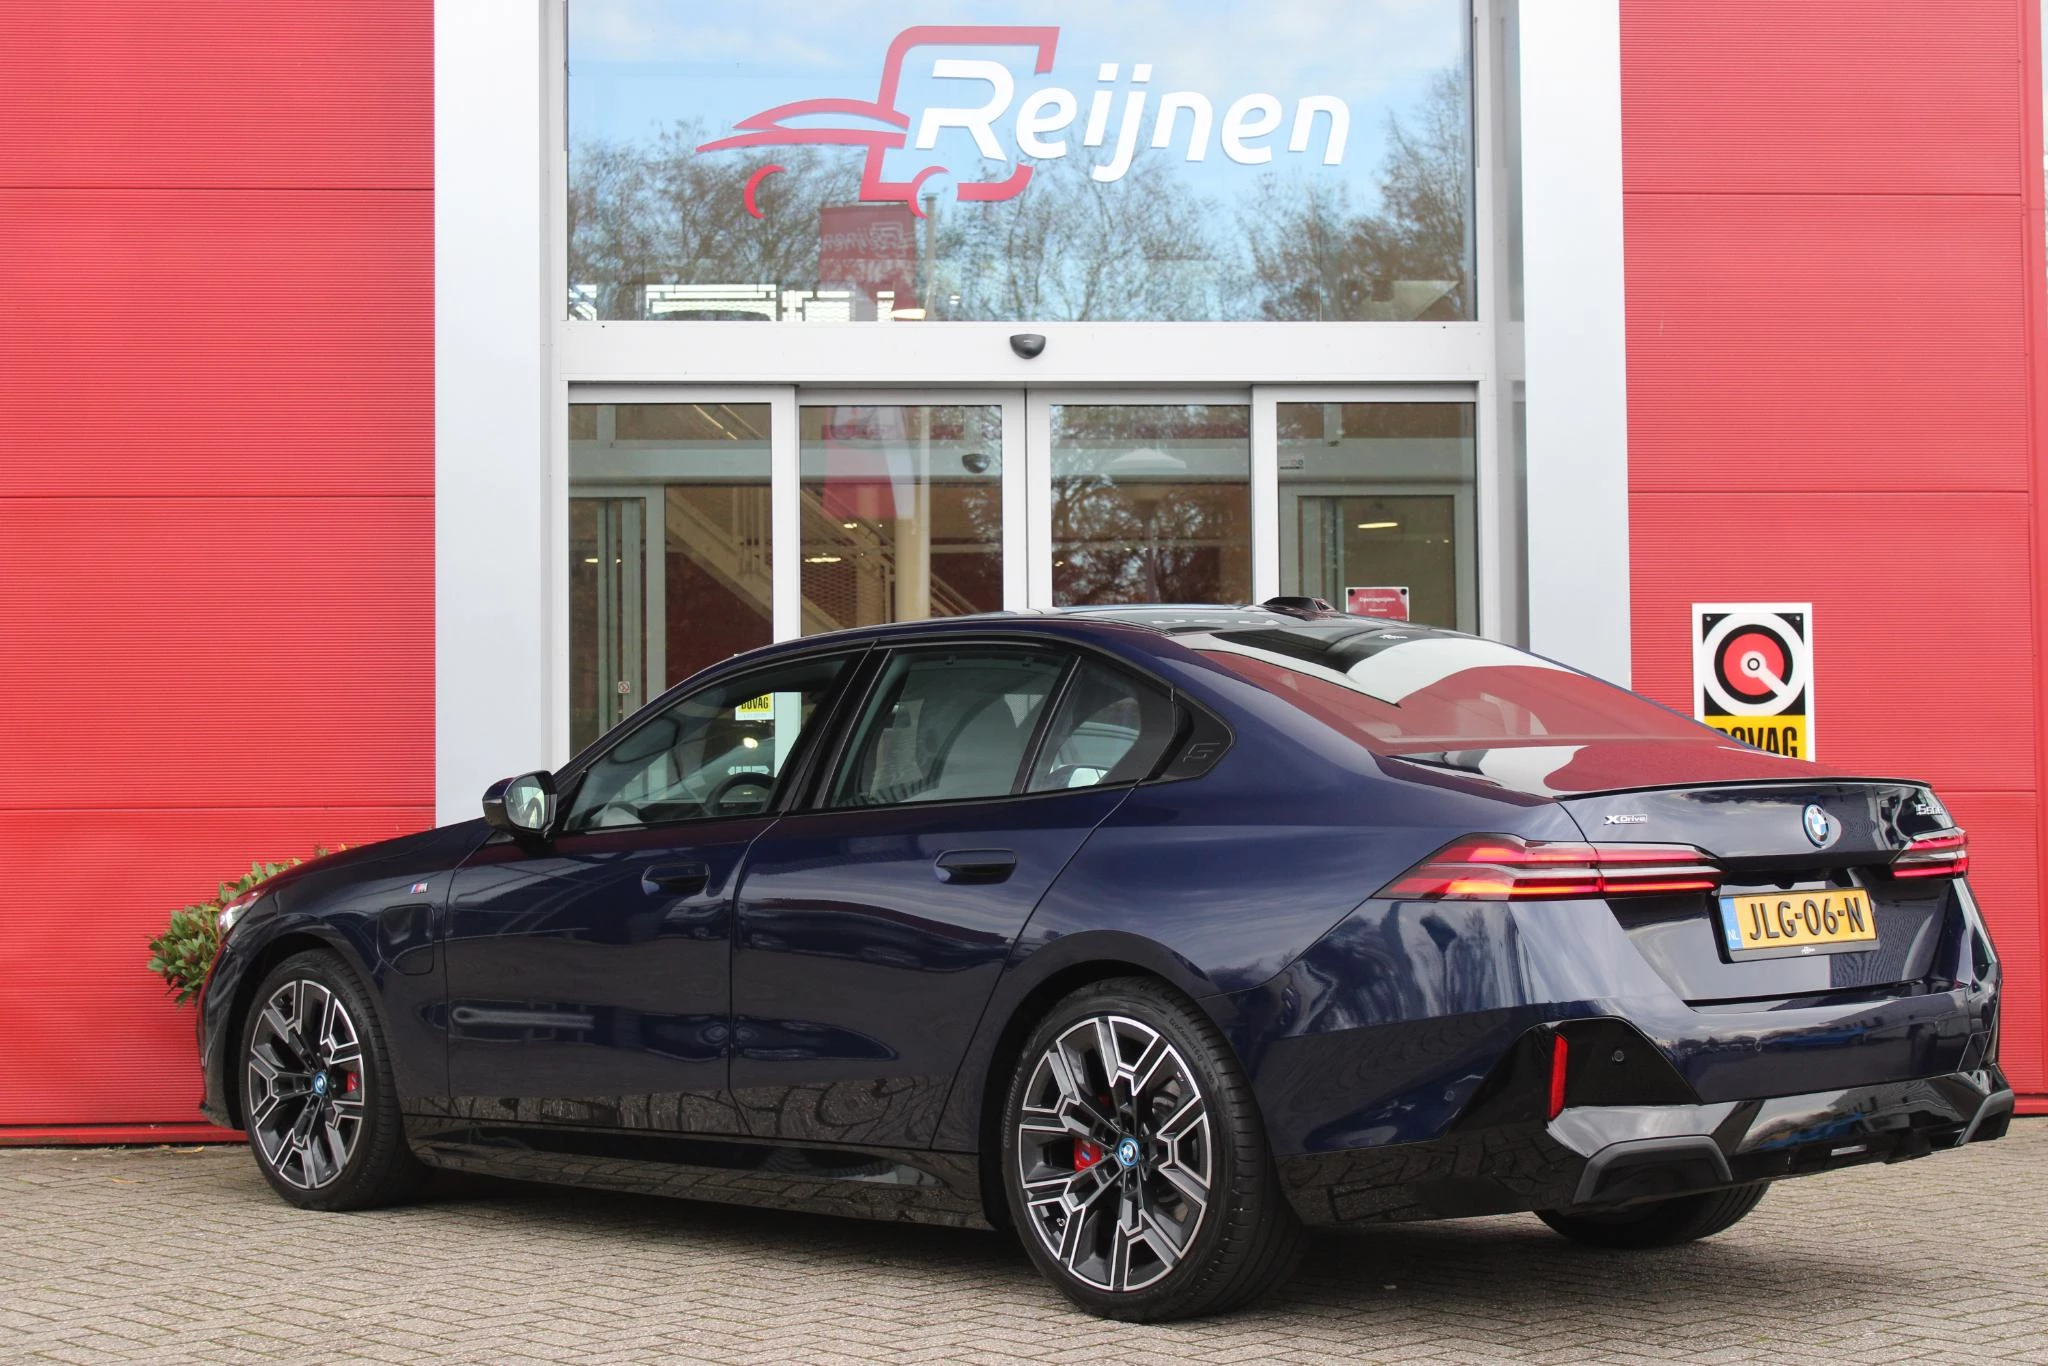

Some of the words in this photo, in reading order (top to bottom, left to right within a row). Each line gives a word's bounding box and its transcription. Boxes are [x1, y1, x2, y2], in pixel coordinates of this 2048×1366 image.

[915, 58, 1351, 183] Reijnen
[1716, 726, 1798, 758] VAG
[1727, 929, 1740, 941] NL
[1750, 897, 1866, 941] JLG-06-N
